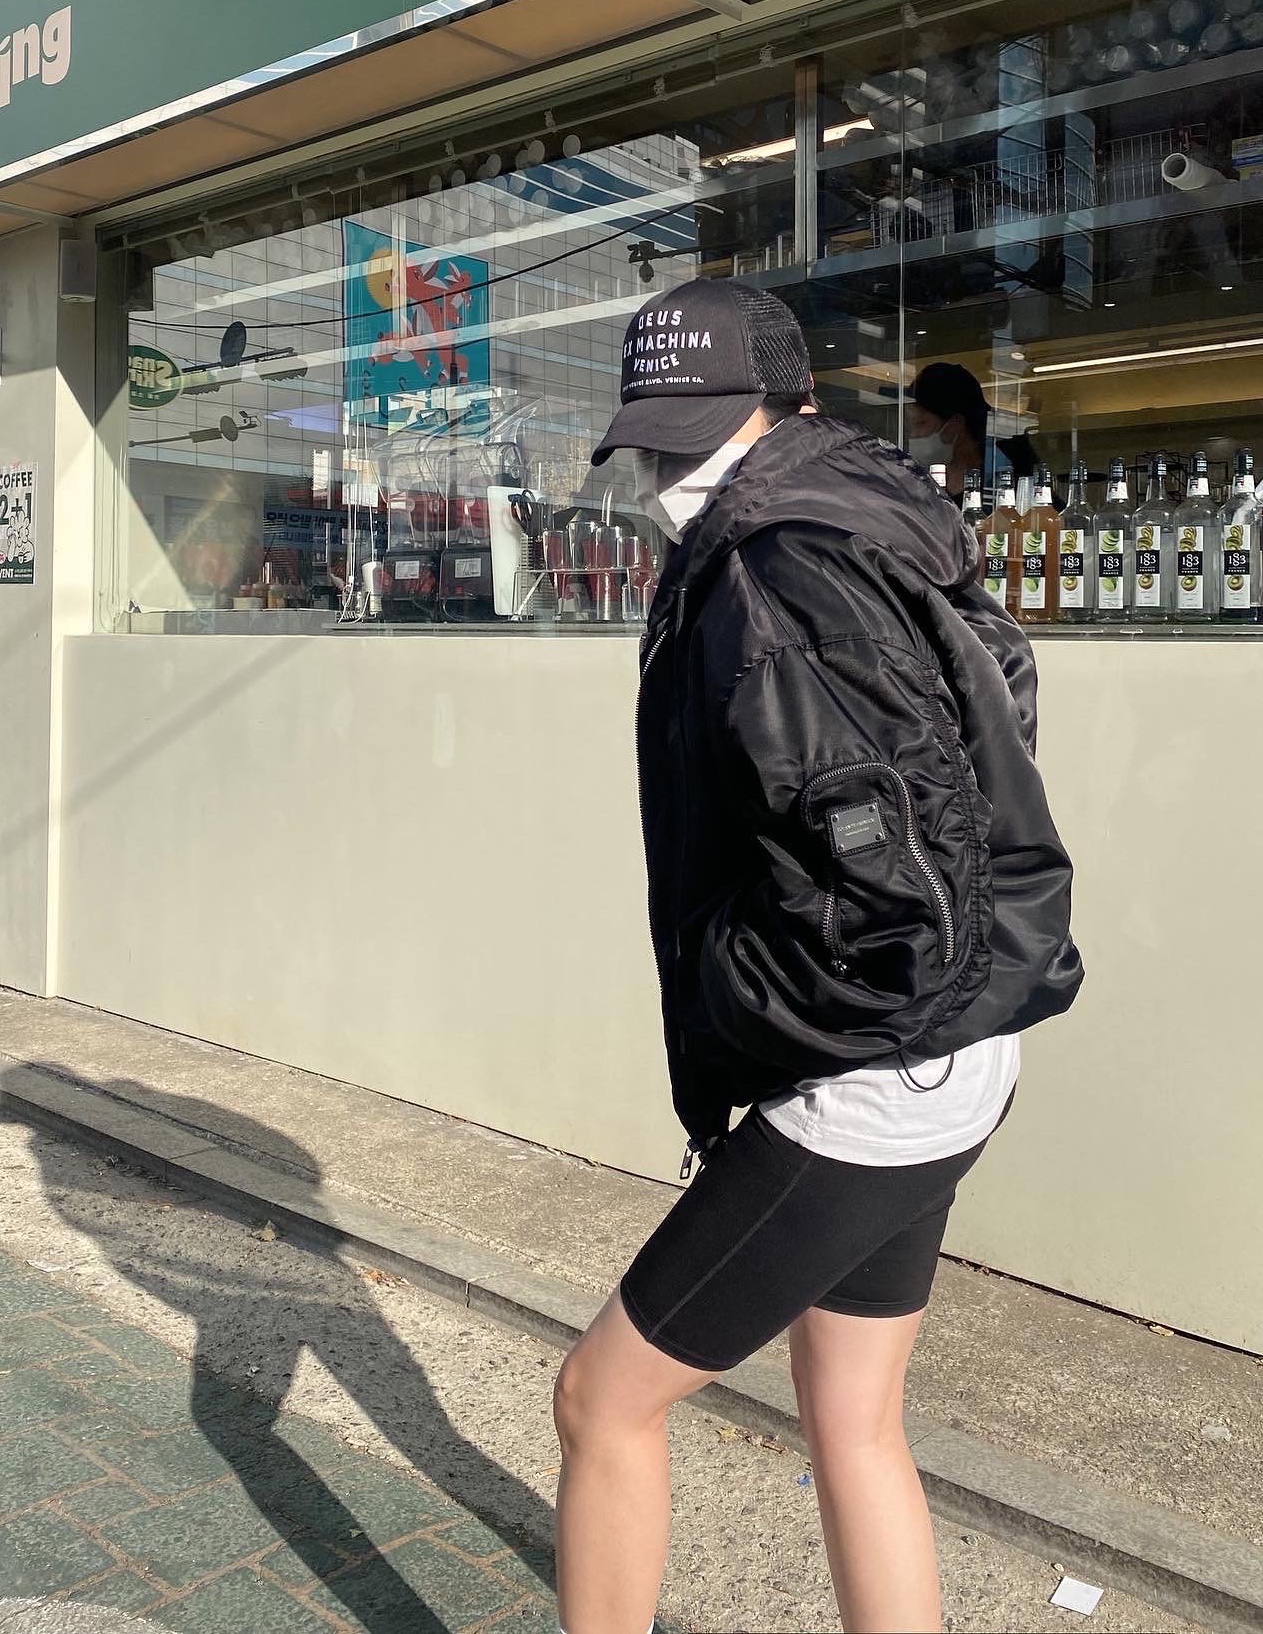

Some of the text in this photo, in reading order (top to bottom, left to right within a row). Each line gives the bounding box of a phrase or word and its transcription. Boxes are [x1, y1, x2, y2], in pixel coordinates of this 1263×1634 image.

[638, 310, 683, 330] DEUS
[623, 331, 712, 359] EX MACHINA
[633, 353, 680, 373] VENICE
